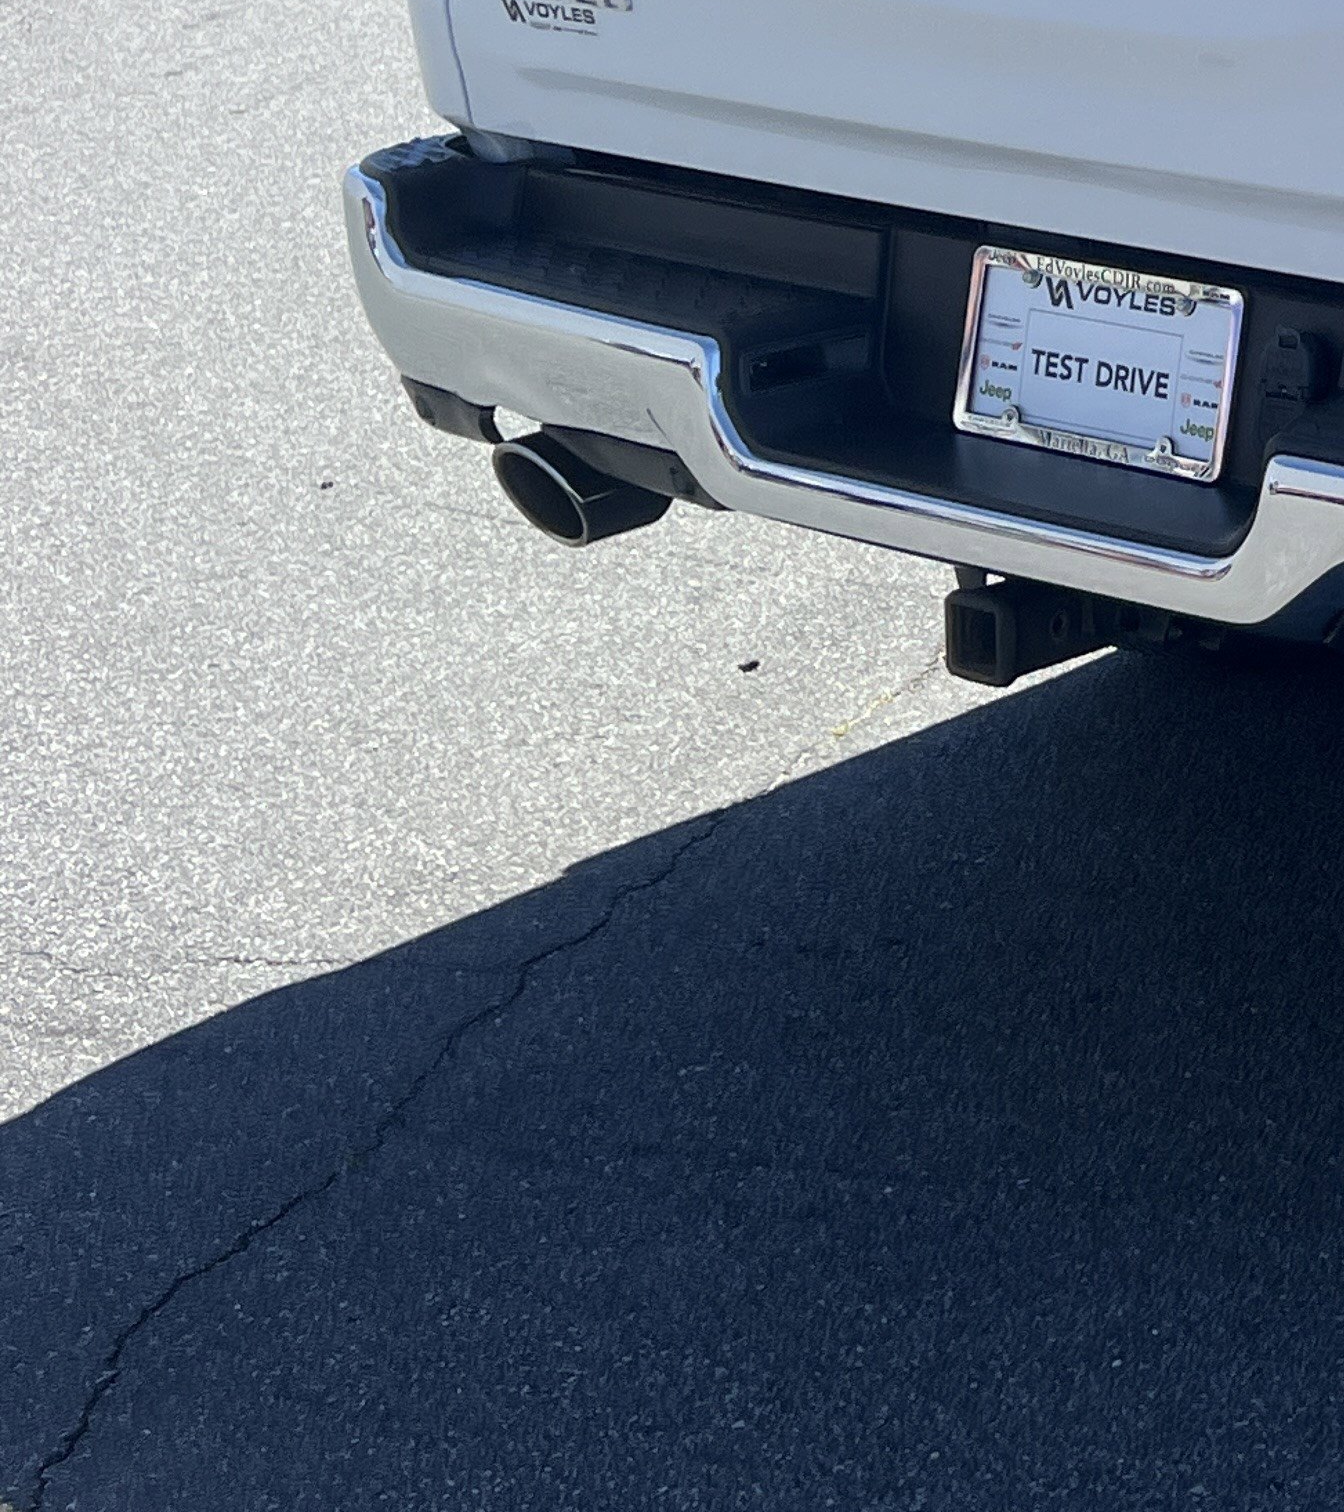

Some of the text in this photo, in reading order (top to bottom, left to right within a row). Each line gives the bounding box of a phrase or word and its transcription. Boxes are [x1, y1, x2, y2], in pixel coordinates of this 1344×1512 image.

[523, 0, 597, 25] VOYLES
[1076, 279, 1177, 317] VOYLES
[1031, 348, 1170, 400] TEST DRIVE
[979, 379, 1013, 402] Jeep
